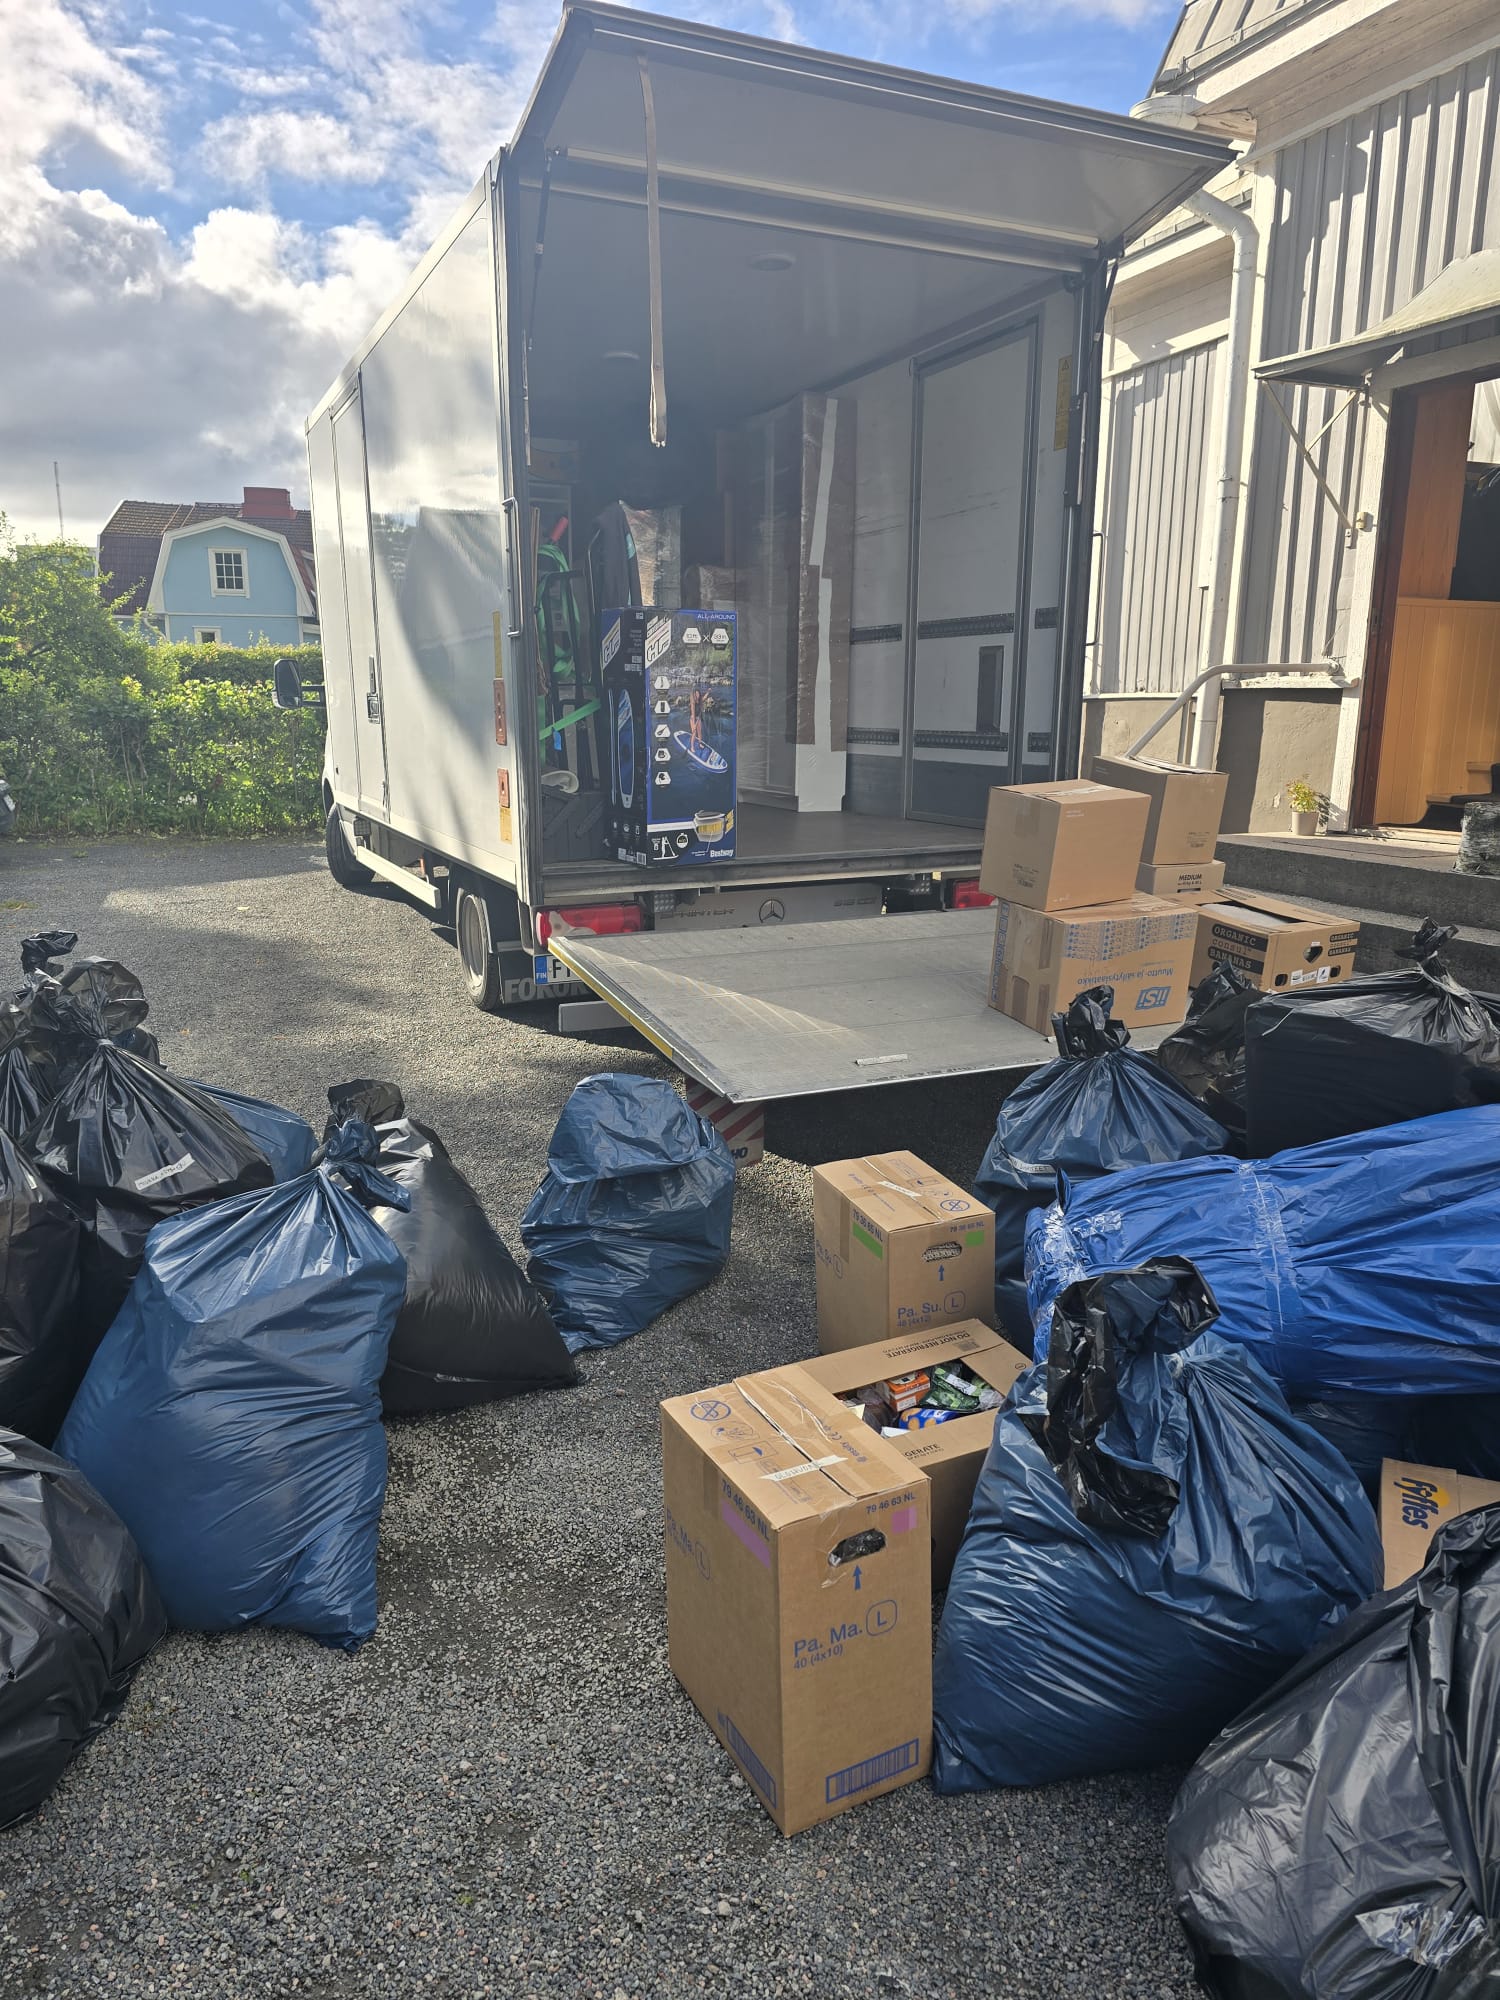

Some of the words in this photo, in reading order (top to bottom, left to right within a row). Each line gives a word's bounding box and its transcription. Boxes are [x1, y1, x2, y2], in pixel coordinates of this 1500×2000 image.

[1178, 873, 1203, 881] MEDIUM
[1214, 926, 1256, 946] ORGANIC
[1209, 948, 1252, 969] BANANAS
[897, 1307, 917, 1320] Pa.
[922, 1302, 942, 1313] Su.
[940, 1335, 957, 1344] NOT
[957, 1331, 970, 1339] DO
[887, 1341, 940, 1358] REFRIGERATE
[904, 1443, 940, 1457] GERATE
[722, 1479, 732, 1498] 79
[757, 1518, 769, 1541] NL
[866, 1504, 877, 1514] 79
[879, 1500, 890, 1511] 46
[891, 1496, 901, 1506] 63
[904, 1492, 916, 1502] NL
[794, 1639, 824, 1658] Pa.
[830, 1623, 863, 1645] Ma.
[877, 1610, 888, 1627] L
[794, 1657, 808, 1669] 40
[811, 1644, 843, 1666] (4x10)
